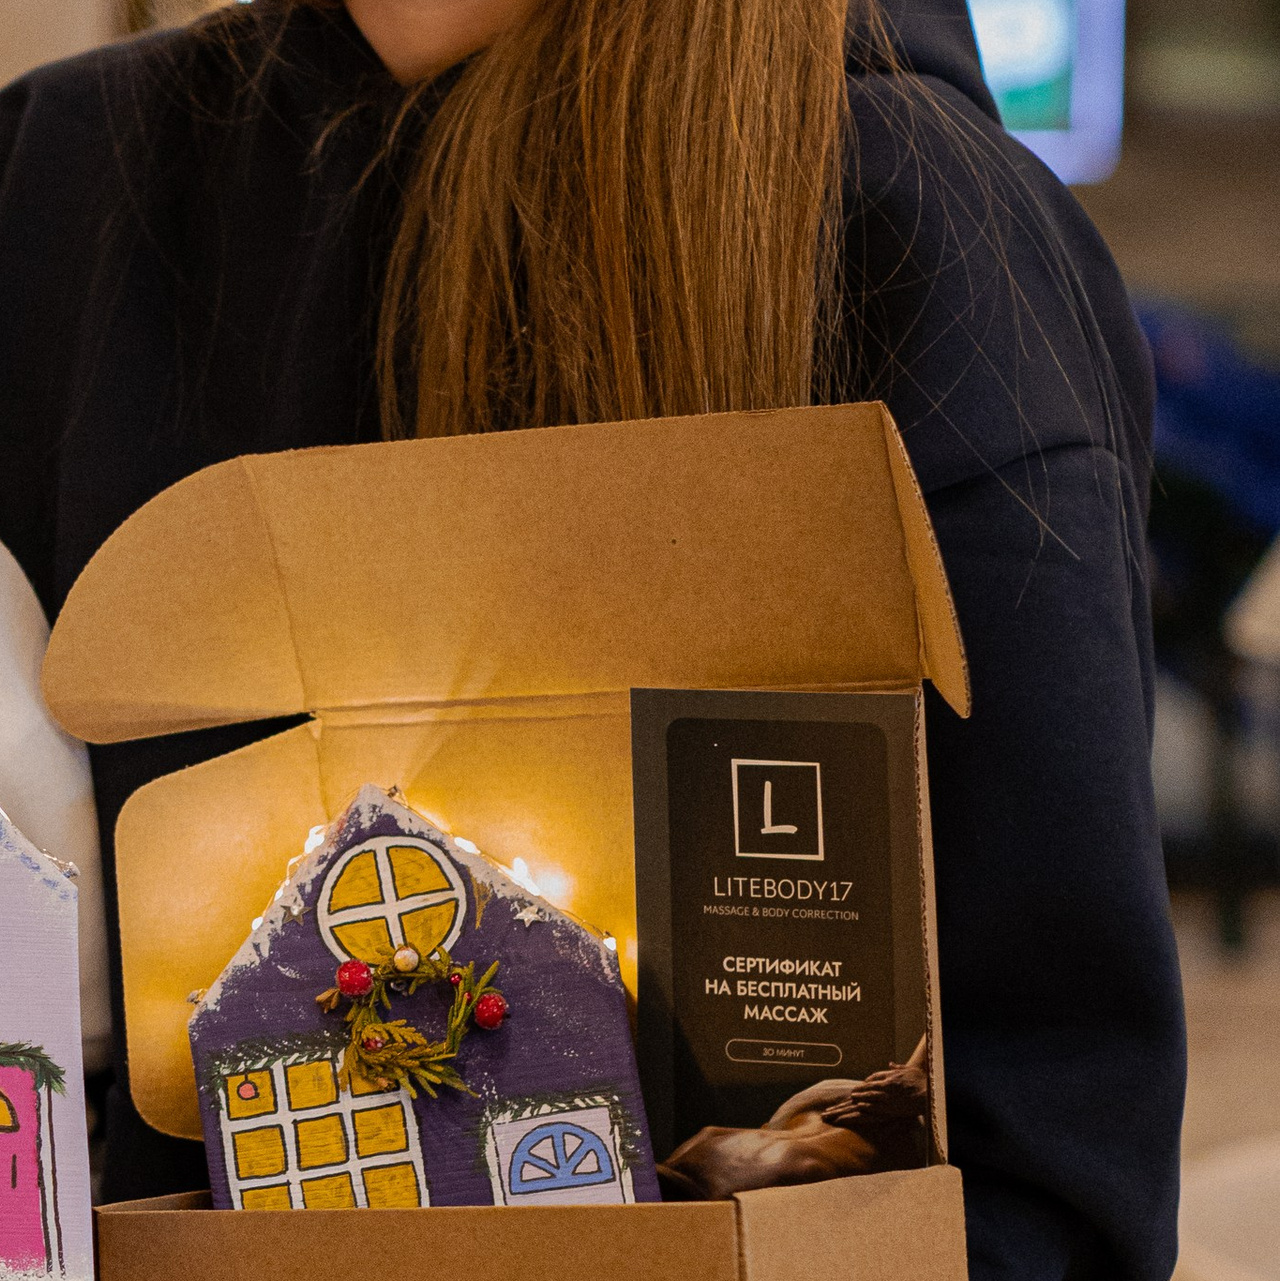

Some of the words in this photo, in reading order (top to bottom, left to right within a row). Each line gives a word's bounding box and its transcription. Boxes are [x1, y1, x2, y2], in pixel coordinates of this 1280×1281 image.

[760, 780, 798, 834] L
[713, 876, 853, 901] LITEBODY17
[703, 905, 750, 917] MASSAGE
[752, 906, 760, 917] &
[762, 907, 790, 918] BODY
[792, 908, 859, 920] CORRECTION
[722, 956, 842, 977] СЕРТИФИКАТ
[705, 978, 731, 995] НА
[737, 980, 861, 1002] БЕСПЛАТНЫЙ
[743, 1004, 829, 1023] МАССАЖ
[762, 1047, 775, 1057] 30
[776, 1048, 805, 1058] МИНУТ
